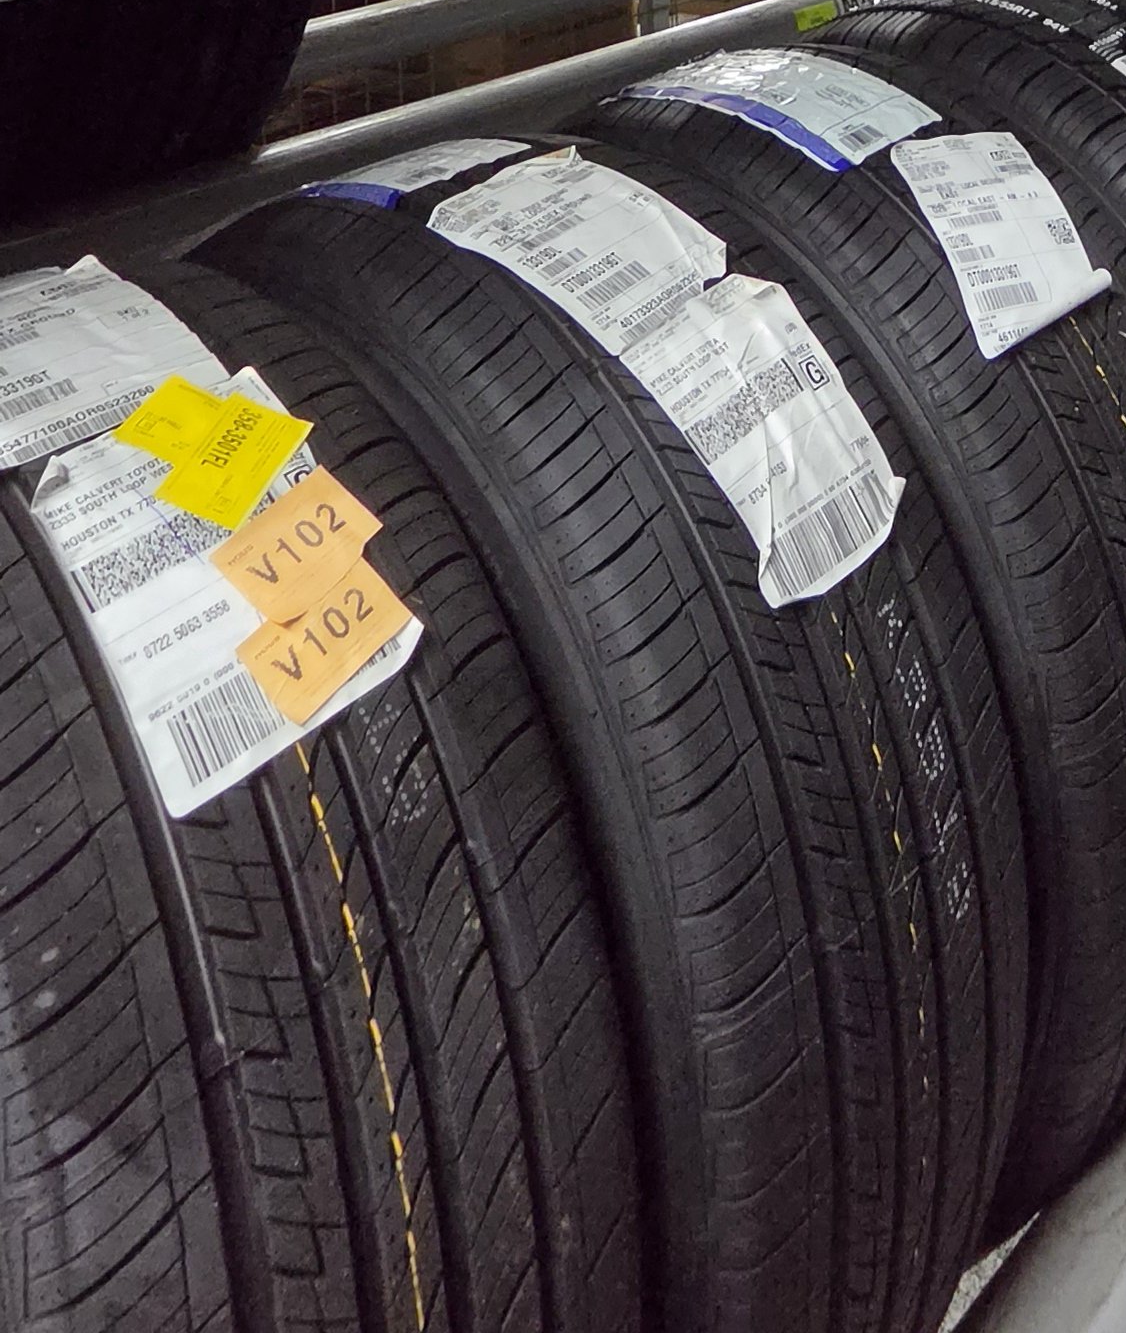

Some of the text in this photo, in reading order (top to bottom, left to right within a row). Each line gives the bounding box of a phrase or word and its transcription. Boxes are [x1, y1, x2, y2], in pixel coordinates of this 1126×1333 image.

[804, 360, 825, 385] G
[669, 386, 703, 415] HOUSTON
[43, 457, 163, 521] MIKE CALVERT TOYOT
[80, 490, 119, 516] SOUTH
[121, 475, 149, 495] LOOP
[61, 494, 158, 551] HOUSTON TX 770
[244, 502, 347, 585] V102
[203, 598, 232, 624] 3558
[270, 587, 374, 682] V102
